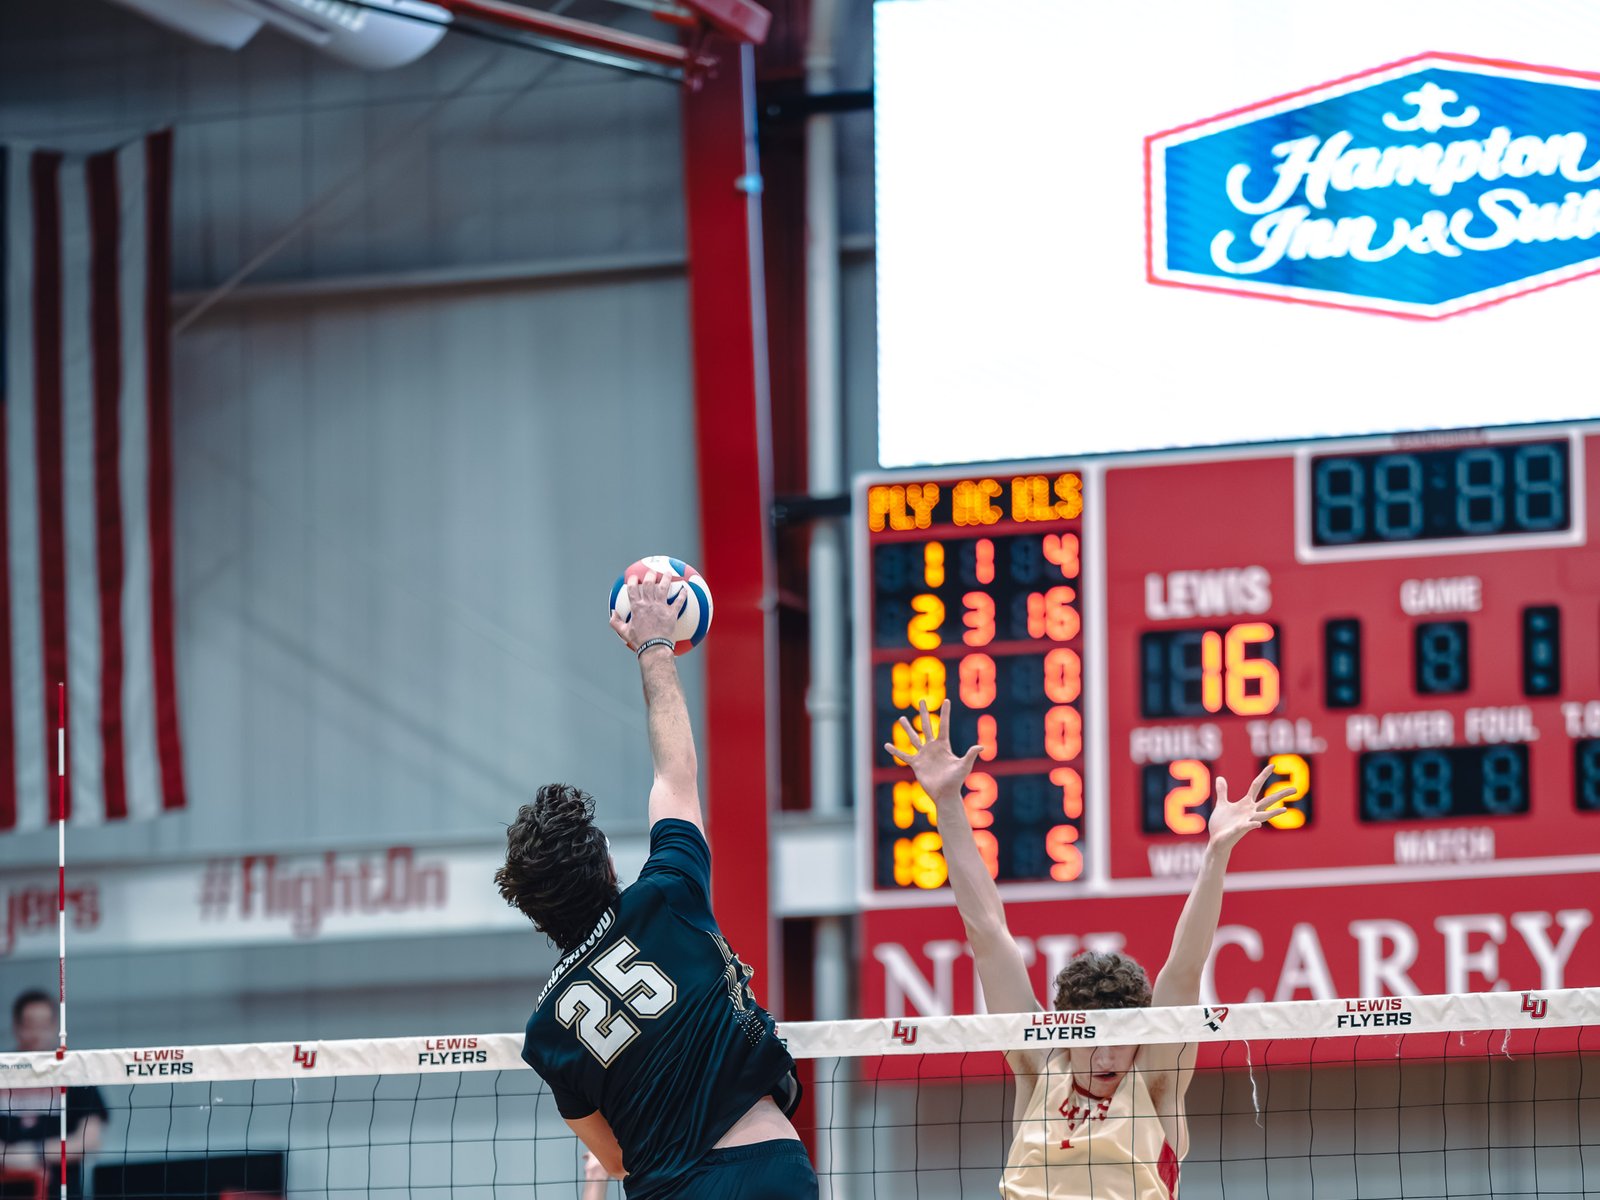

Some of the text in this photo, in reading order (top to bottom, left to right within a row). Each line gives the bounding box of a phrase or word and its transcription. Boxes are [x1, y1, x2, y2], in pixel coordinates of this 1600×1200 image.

[1226, 126, 1600, 214] Hampton
[924, 533, 1080, 588] 1 1 4
[907, 585, 1081, 650] 2 3 16
[1145, 566, 1271, 620] LEWIS
[1400, 576, 1482, 616] GAME
[959, 653, 997, 710] 0
[1043, 648, 1081, 704] 0
[1202, 622, 1280, 717] 16
[1044, 705, 1082, 762] 0
[1130, 723, 1222, 764] FOULS
[1346, 710, 1454, 751] PLAYER
[963, 771, 998, 829] 2
[1164, 759, 1210, 834] 2
[1265, 754, 1310, 829] 2
[1046, 824, 1083, 882] 5
[1394, 826, 1495, 865] MATCH
[1201, 909, 1593, 1005] CAREY
[555, 936, 677, 1069] 25
[1032, 1013, 1086, 1026] LEWIS
[1338, 1012, 1412, 1028] FLYERS
[1346, 998, 1402, 1012] LEWIS
[133, 1049, 184, 1061] LEWIS
[418, 1049, 487, 1065] FLYERS
[426, 1037, 477, 1050] LEWIS
[1024, 1026, 1096, 1041] FLYERS
[126, 1060, 193, 1076] FLYERS
